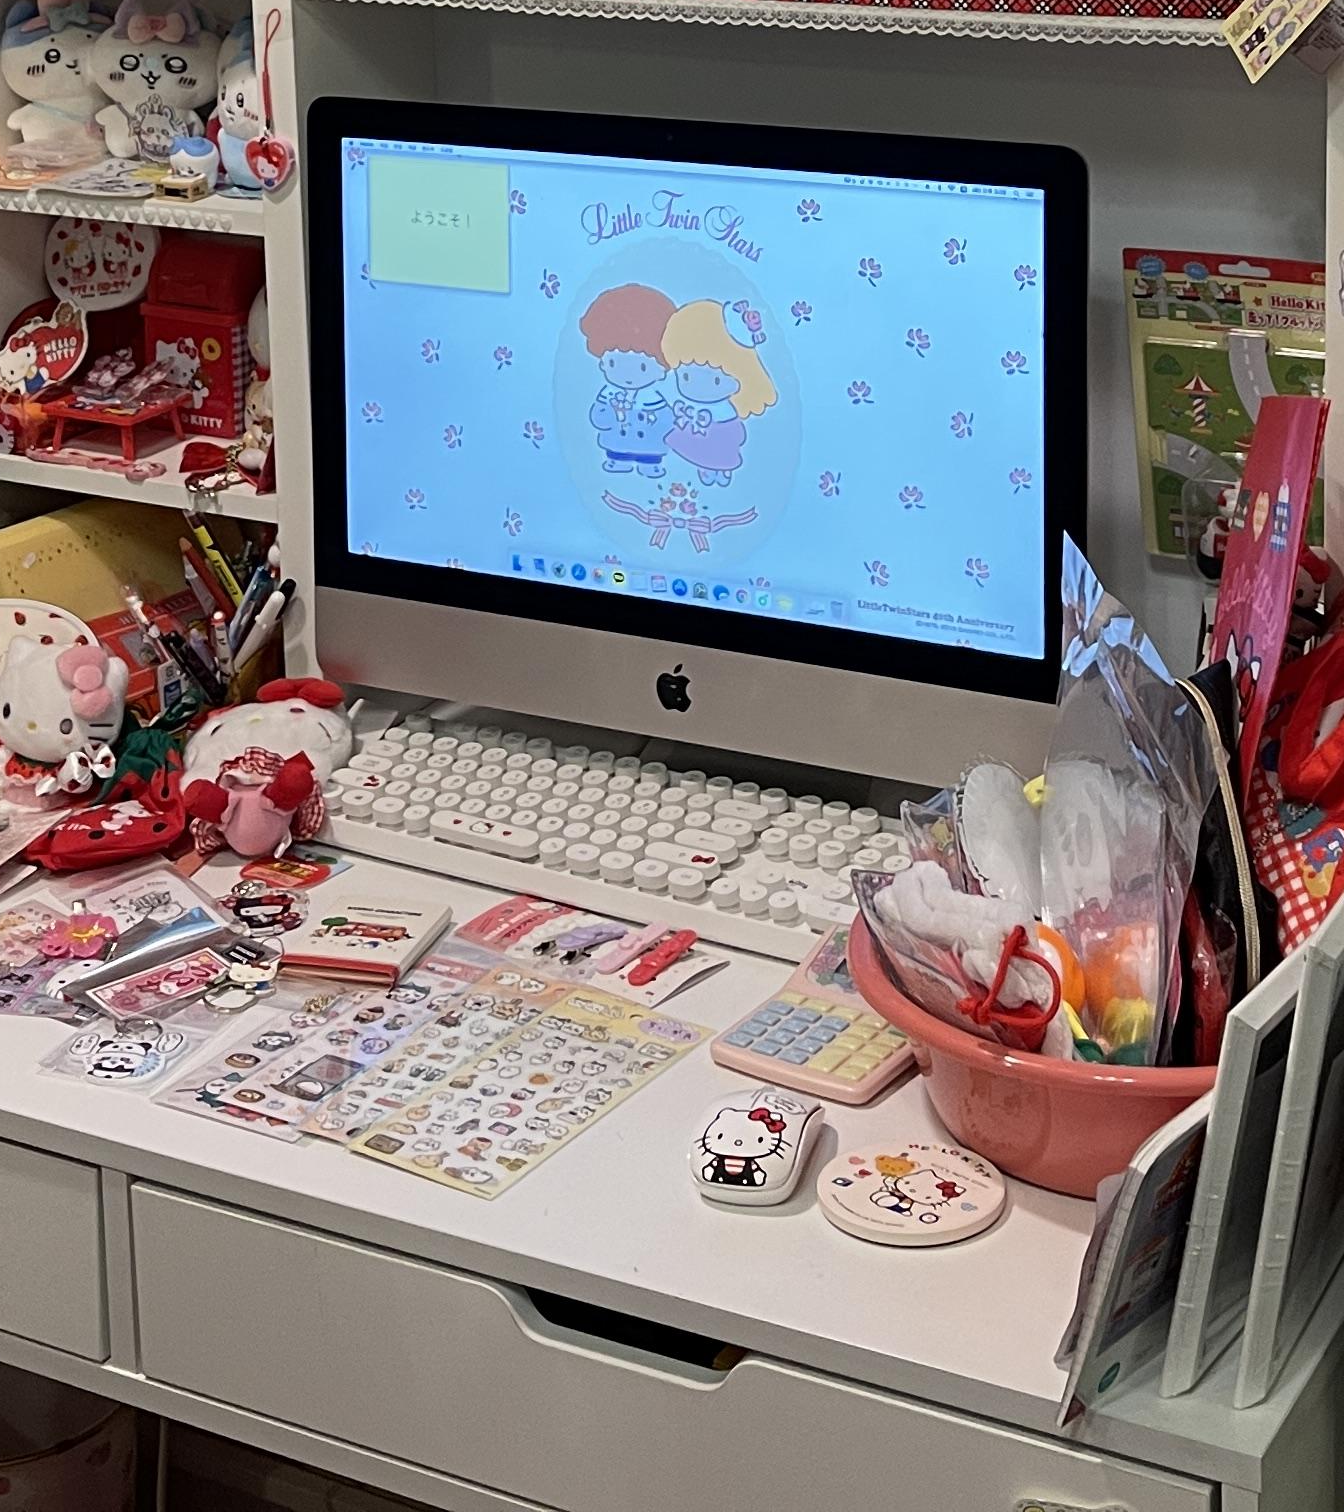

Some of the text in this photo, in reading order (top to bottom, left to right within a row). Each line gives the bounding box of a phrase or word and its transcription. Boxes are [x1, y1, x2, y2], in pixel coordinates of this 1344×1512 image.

[580, 188, 764, 263] Little Twin Stars
[1270, 295, 1304, 310] Hello
[43, 337, 77, 353] HELLO
[46, 349, 76, 364] KITTY
[190, 413, 224, 430] KITTY
[856, 599, 931, 620] LittleTwinStars
[932, 611, 955, 623] 40th
[956, 614, 1016, 634] Anniversary
